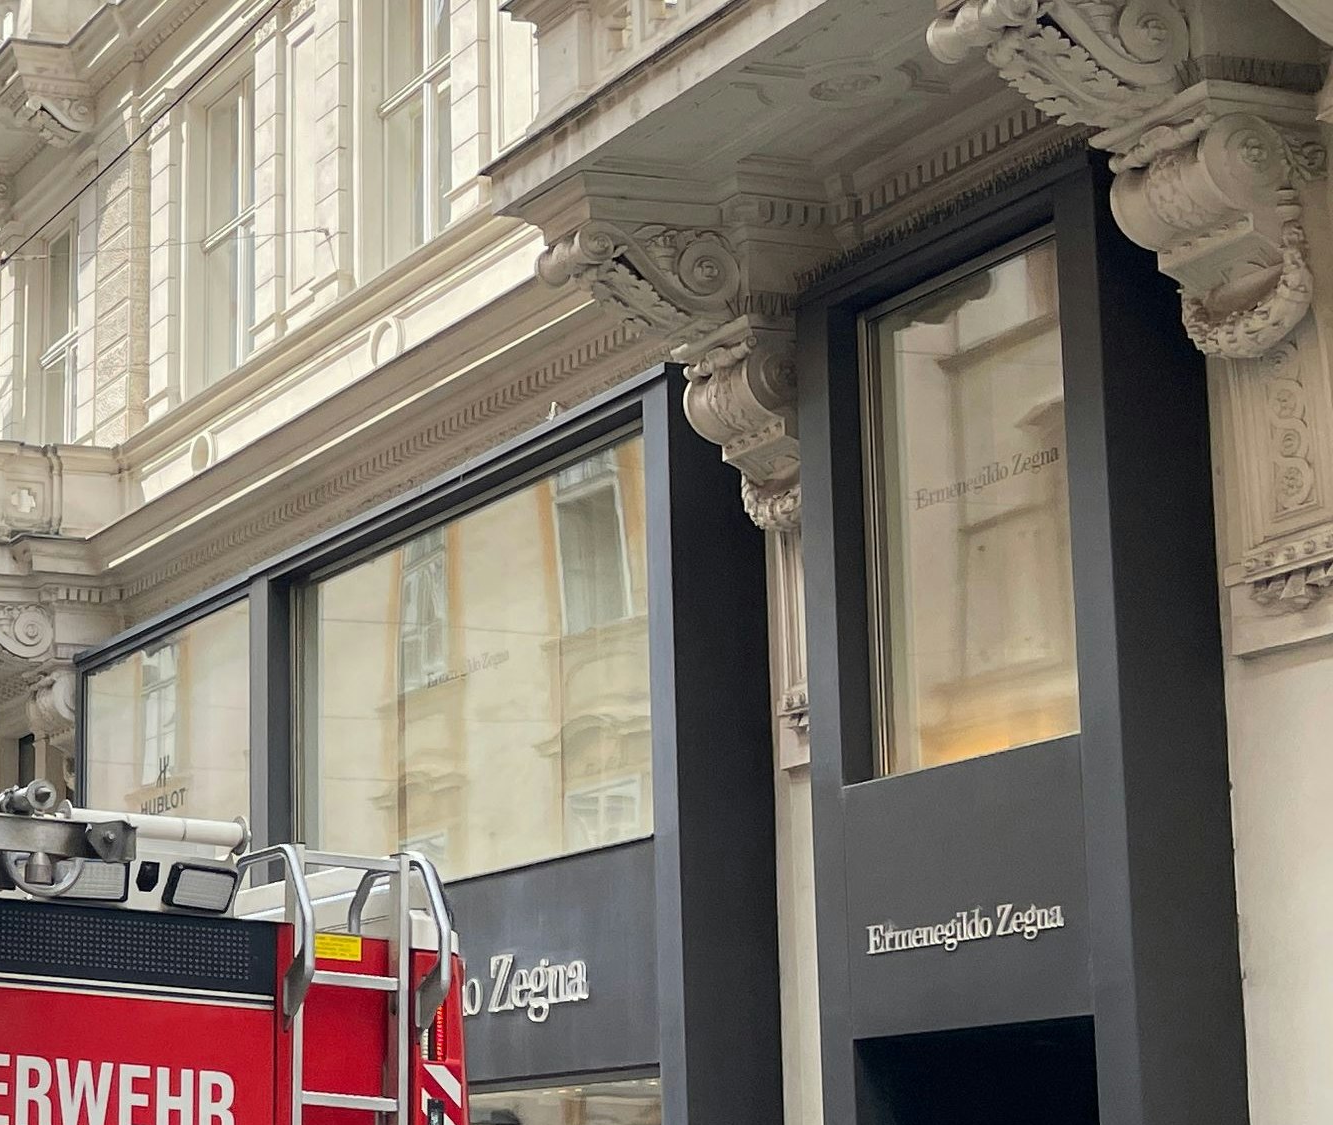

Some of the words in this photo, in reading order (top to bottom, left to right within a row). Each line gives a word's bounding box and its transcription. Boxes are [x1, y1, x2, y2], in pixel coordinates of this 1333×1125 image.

[915, 461, 1009, 511] Ermenegildo
[1012, 447, 1061, 475] Zegna
[140, 788, 187, 815] HUBLOT
[866, 907, 993, 955] Ermenegildo
[996, 903, 1065, 940] Zegna
[488, 953, 590, 1023] Zegna
